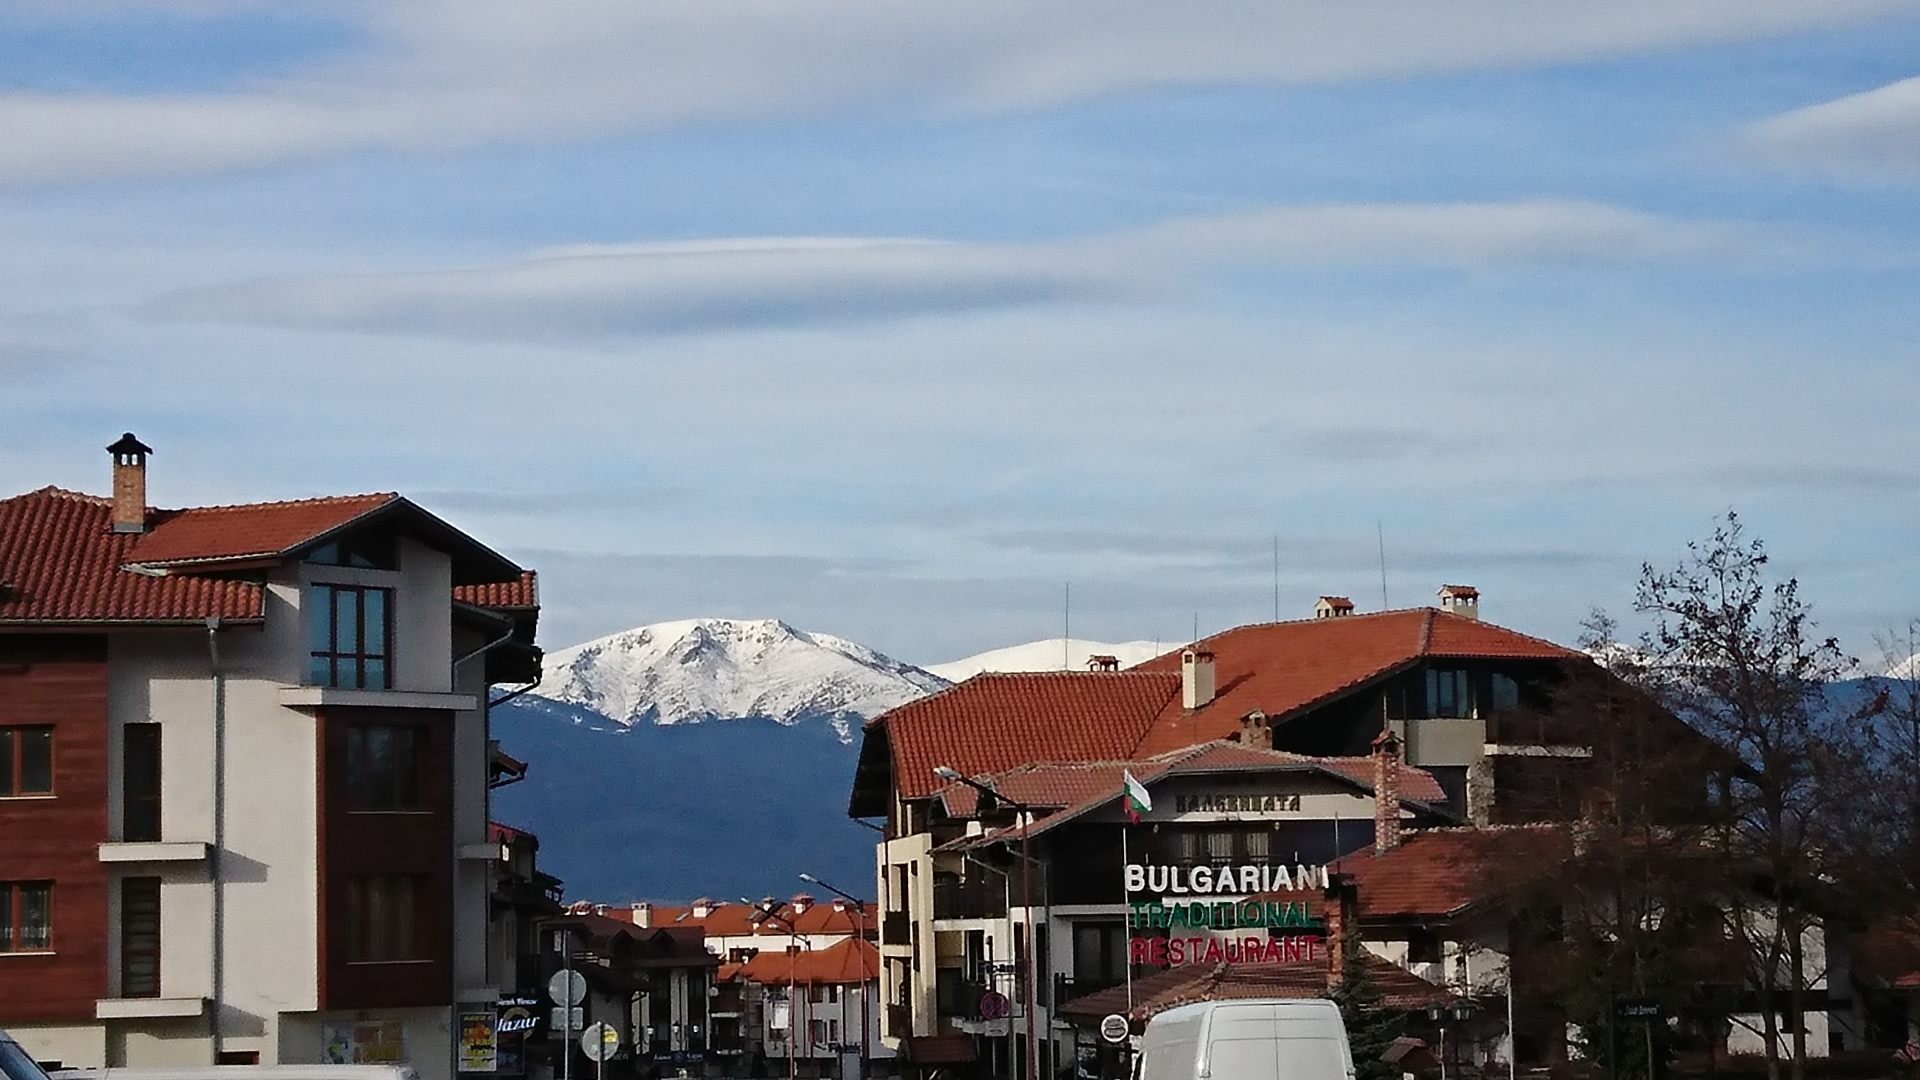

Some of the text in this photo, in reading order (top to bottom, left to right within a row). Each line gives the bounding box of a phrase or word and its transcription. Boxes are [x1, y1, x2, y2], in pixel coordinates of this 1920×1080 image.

[1125, 864, 1317, 892] BULGARIAN
[1130, 901, 1319, 928] TRADITIONAL
[1130, 935, 1319, 965] RESTAURANT
